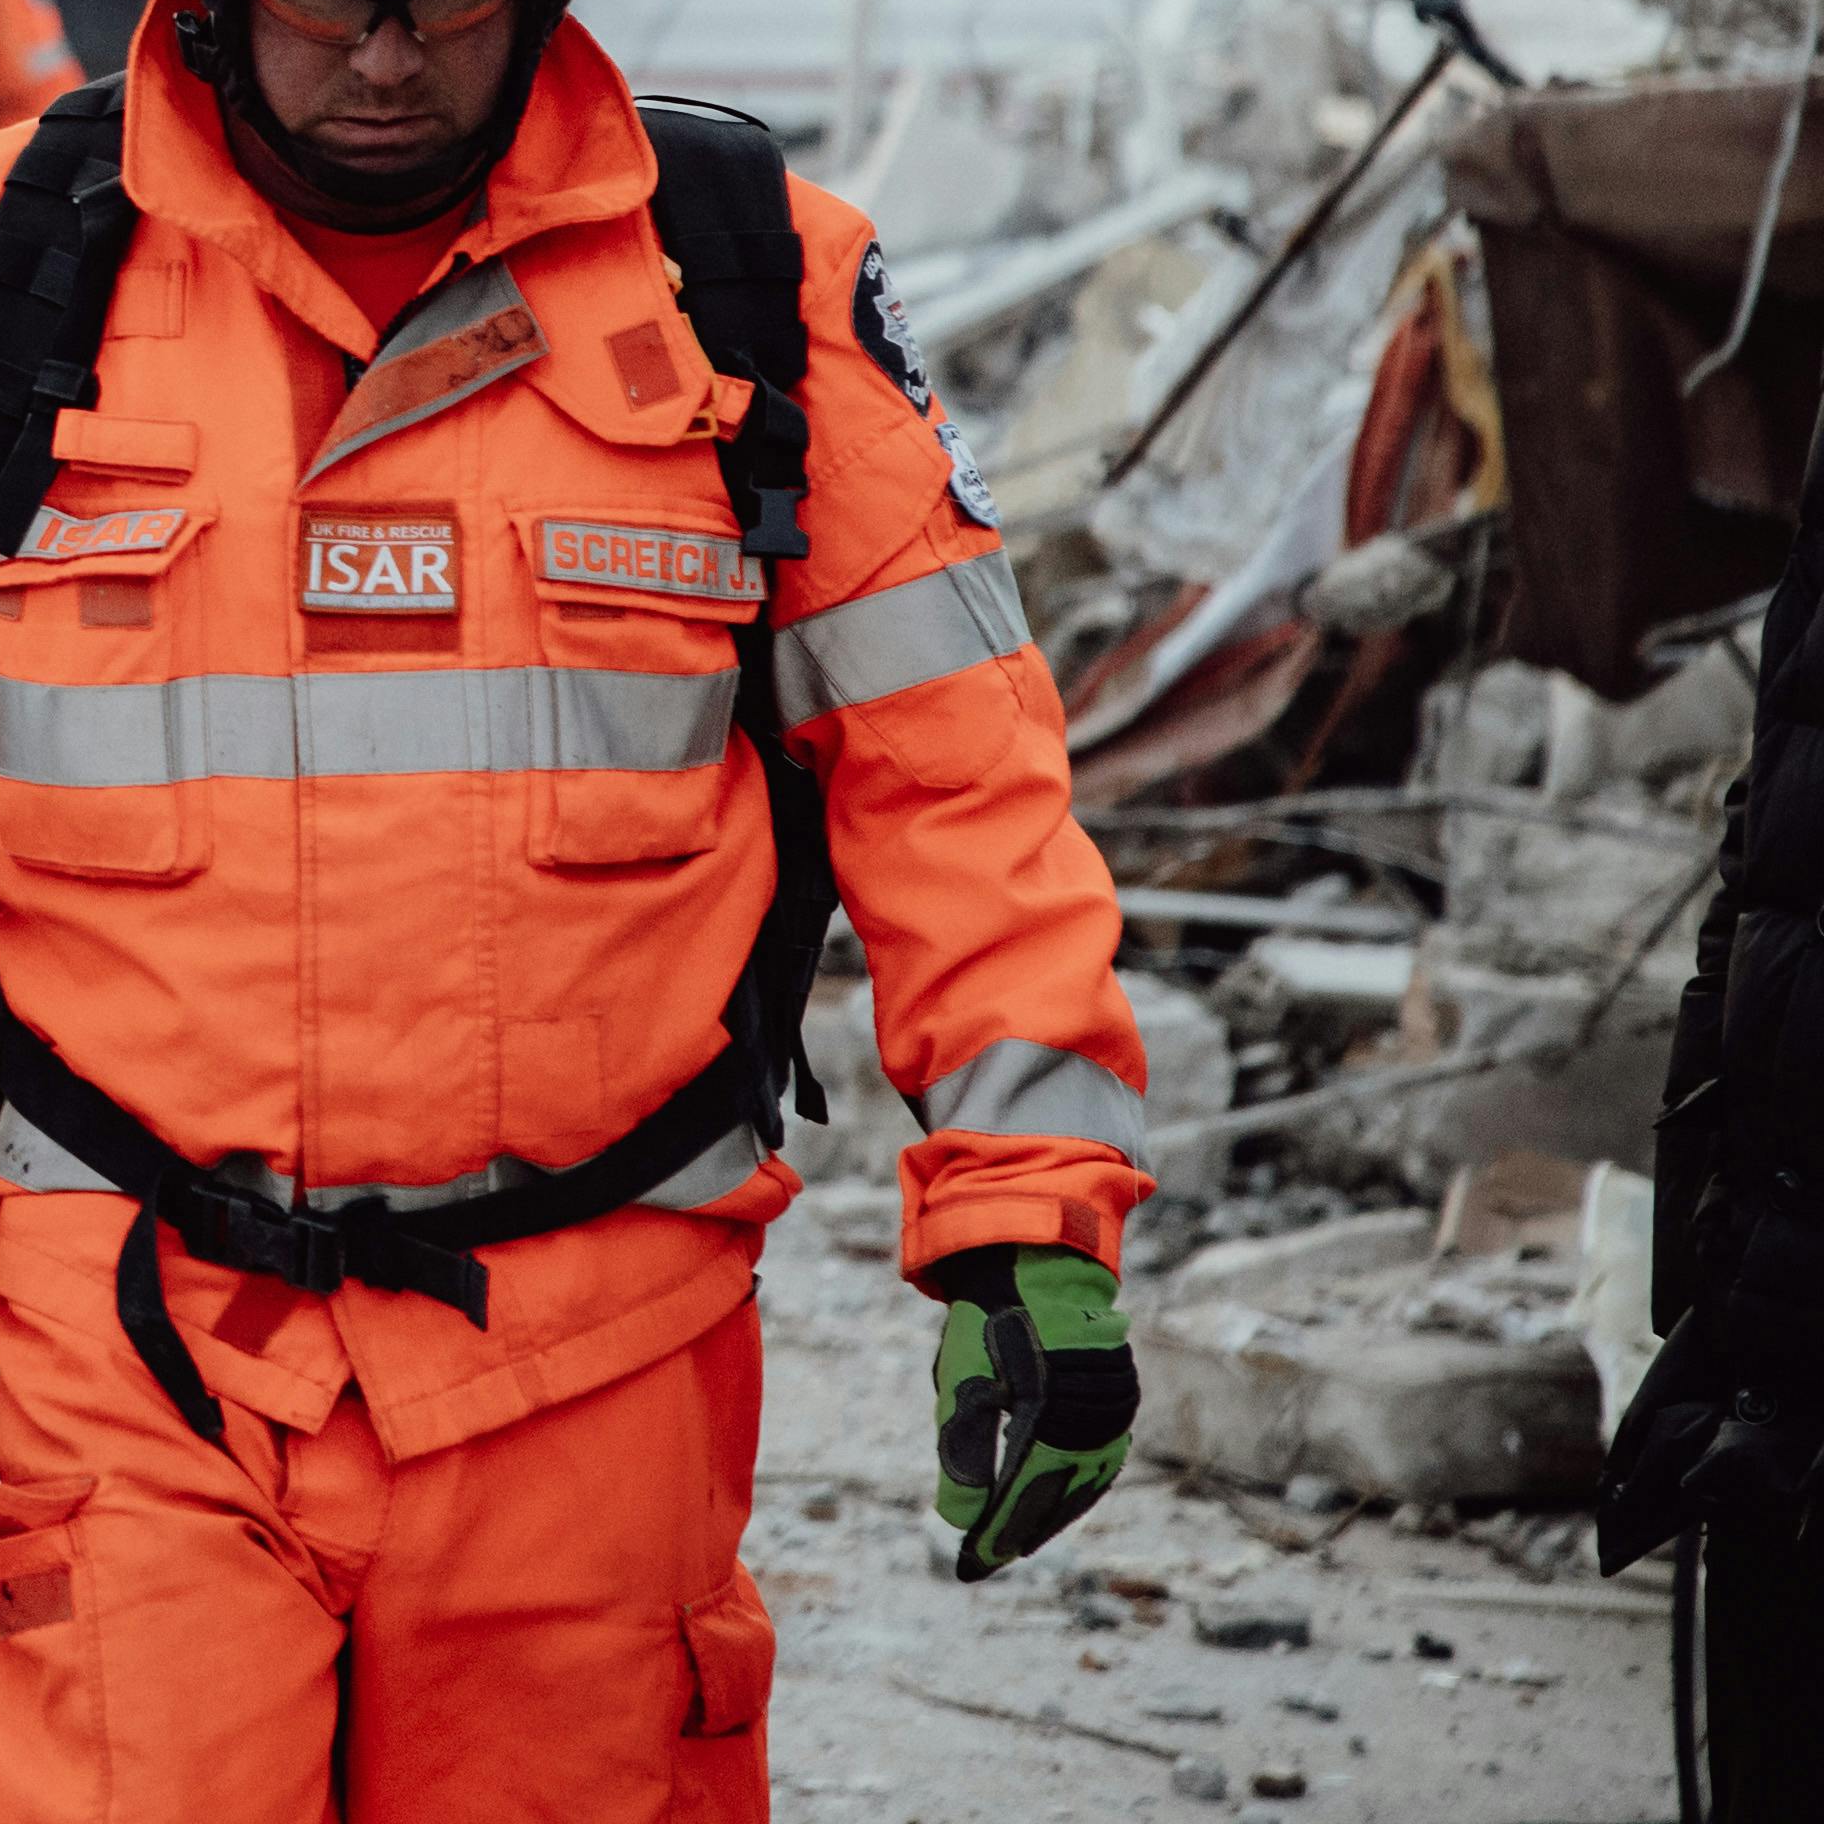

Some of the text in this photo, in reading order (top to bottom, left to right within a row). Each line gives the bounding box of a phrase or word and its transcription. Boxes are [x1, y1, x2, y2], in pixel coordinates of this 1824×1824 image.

[37, 514, 174, 552] ISAR
[310, 525, 452, 539] UK FIRE & RESCUE
[308, 543, 454, 593] ISAR
[553, 531, 720, 588] SCREECH
